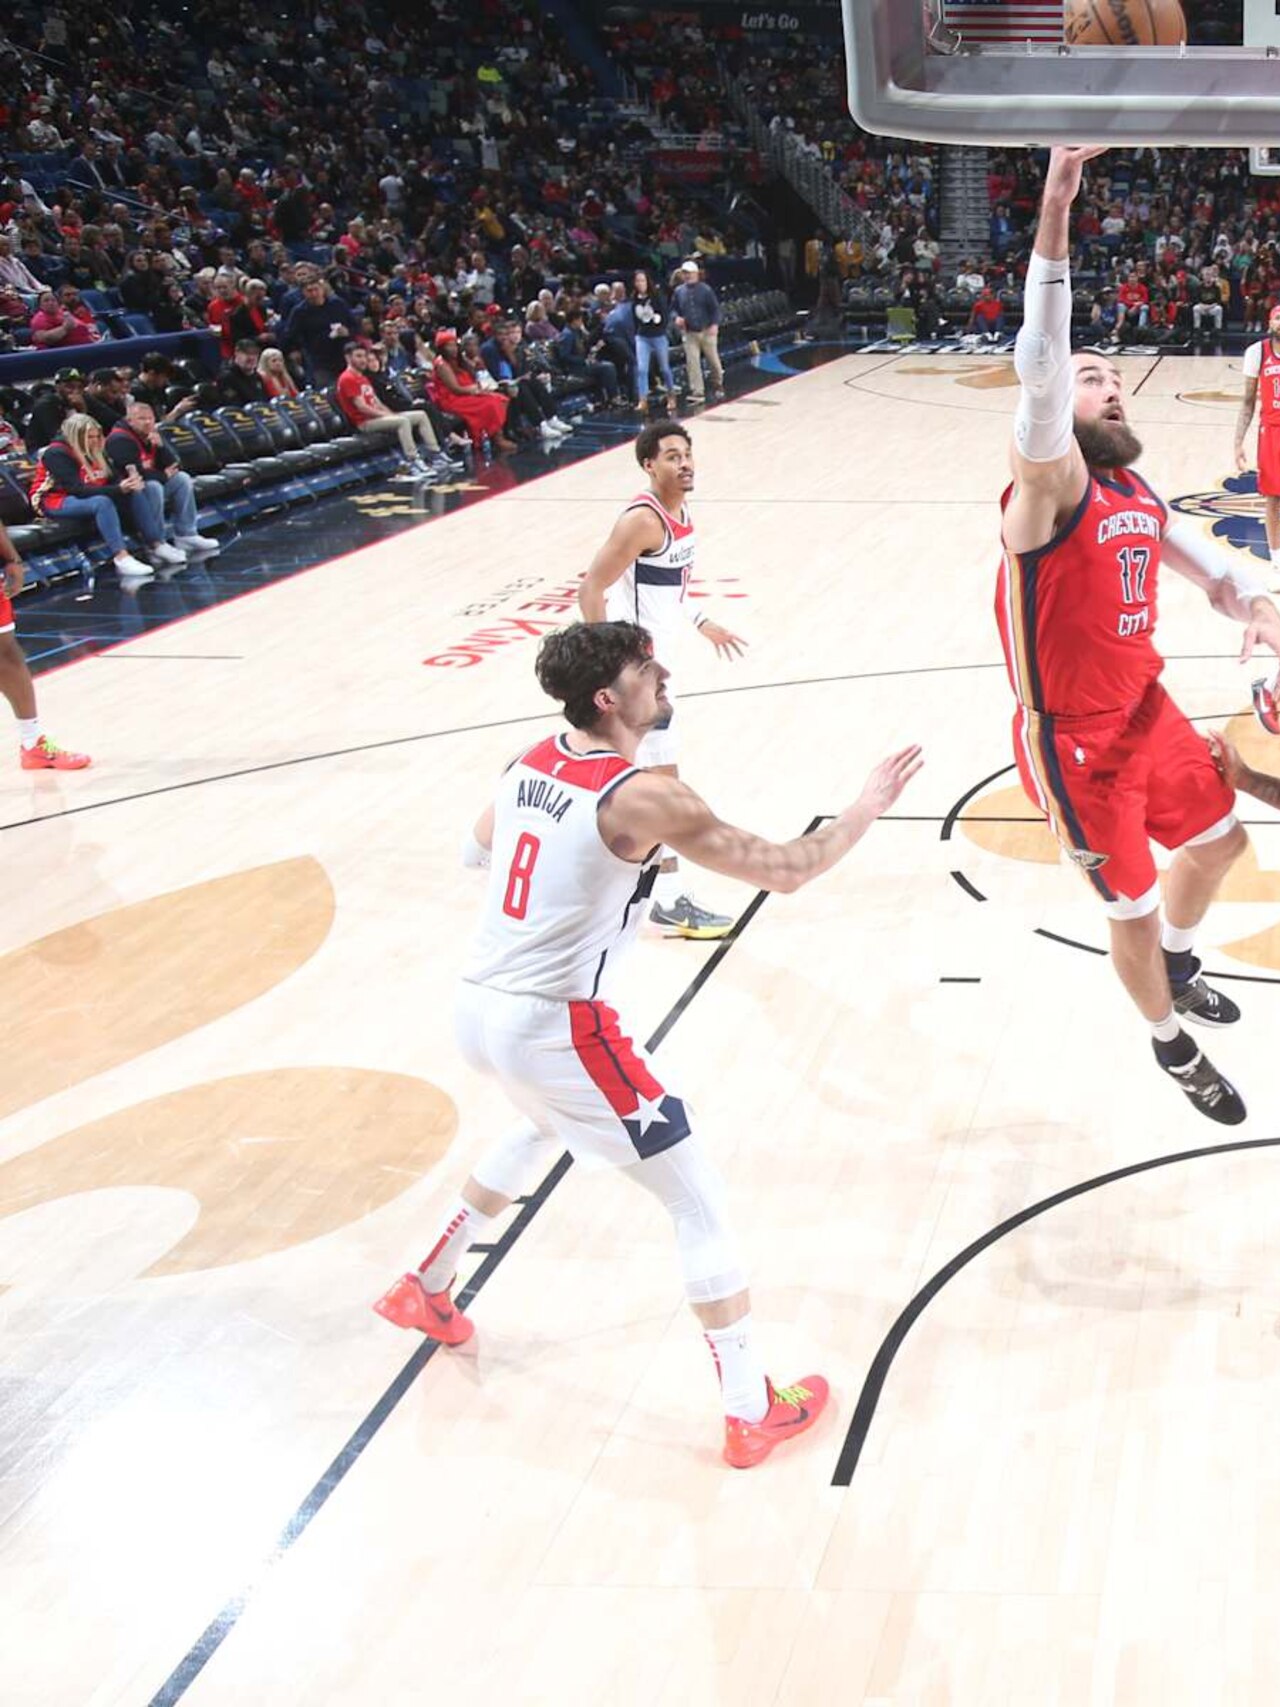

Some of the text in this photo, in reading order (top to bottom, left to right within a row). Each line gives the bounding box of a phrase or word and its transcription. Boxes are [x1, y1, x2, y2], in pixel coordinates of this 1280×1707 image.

[741, 12, 800, 29] Let's Go
[1097, 510, 1162, 545] CRESCENT
[1116, 546, 1151, 604] 17
[1117, 605, 1149, 637] CITY
[517, 778, 574, 823] AVDIJA
[502, 830, 541, 921] 8
